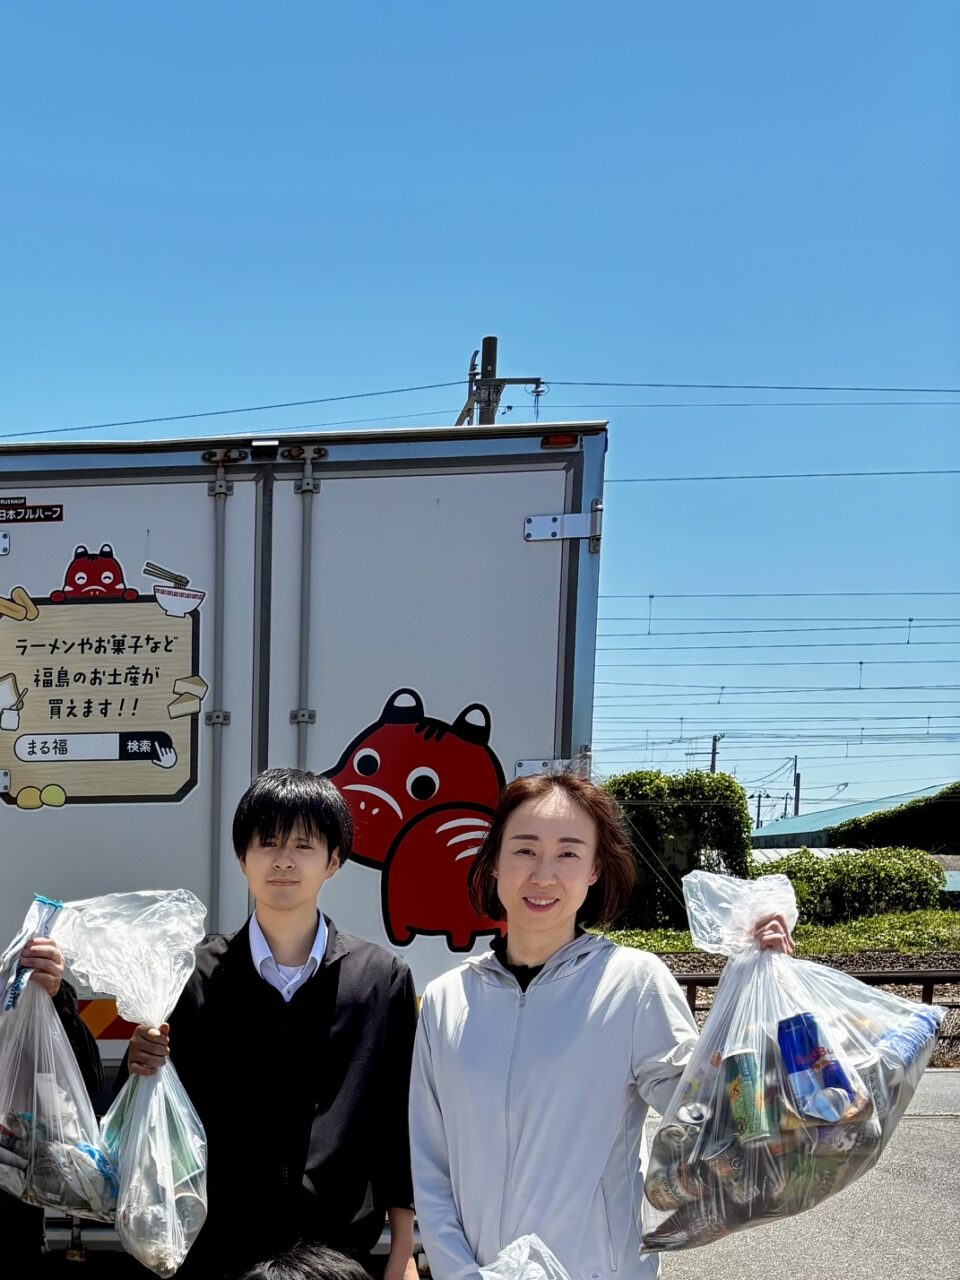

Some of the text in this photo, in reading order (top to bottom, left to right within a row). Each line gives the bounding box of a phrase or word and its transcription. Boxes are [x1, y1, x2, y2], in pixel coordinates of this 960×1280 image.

[15, 634, 179, 656] ラーメンやお菓子など
[33, 665, 160, 688] 福島のお土産が
[26, 739, 68, 756] まる福
[126, 740, 151, 753] 検索
